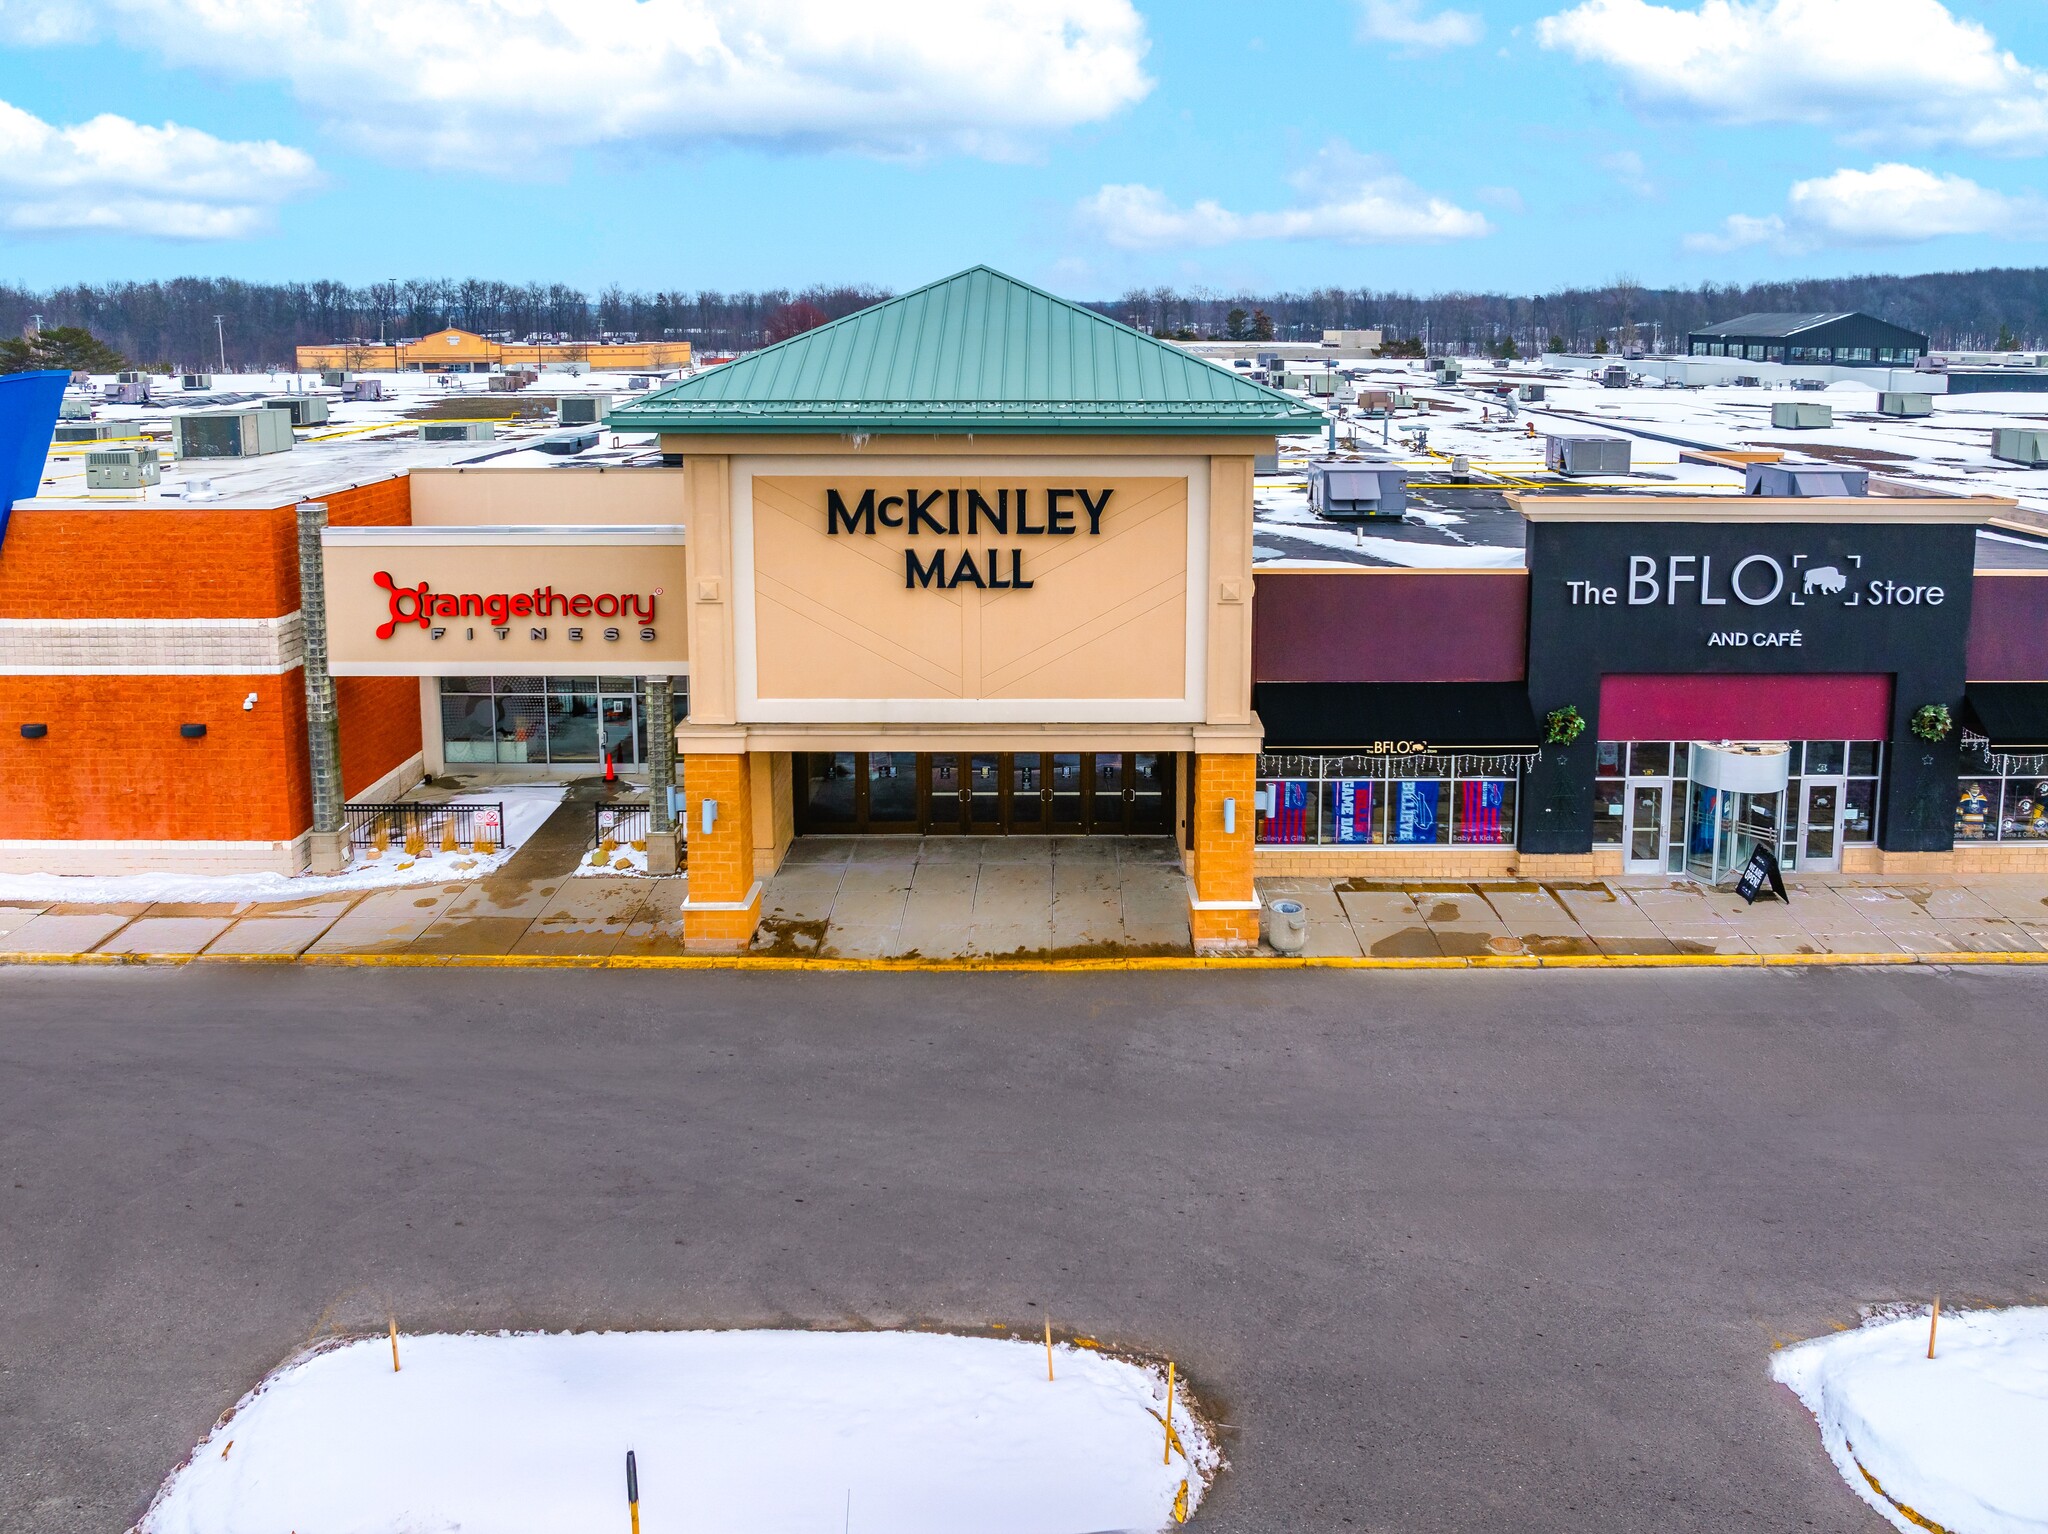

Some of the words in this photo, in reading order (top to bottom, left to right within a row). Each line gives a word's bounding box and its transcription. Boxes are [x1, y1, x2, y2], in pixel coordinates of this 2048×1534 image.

[826, 488, 1115, 535] McKINLEY
[904, 548, 1035, 589] MALL
[1566, 580, 1618, 605] The
[1628, 554, 1784, 606] BFLO
[1867, 580, 1945, 606] Store
[431, 627, 657, 641] FITNESS
[1707, 632, 1748, 647] AND
[1752, 629, 1803, 647] CAFÉ
[1374, 740, 1411, 754] BFLO
[1341, 781, 1354, 815] GAME
[1340, 817, 1353, 841] DAY
[1453, 834, 1471, 842] Baby
[1256, 835, 1282, 843] Gallery
[1290, 834, 1306, 842] Gifts
[1748, 861, 1757, 873] WE
[1754, 867, 1765, 879] ARE
